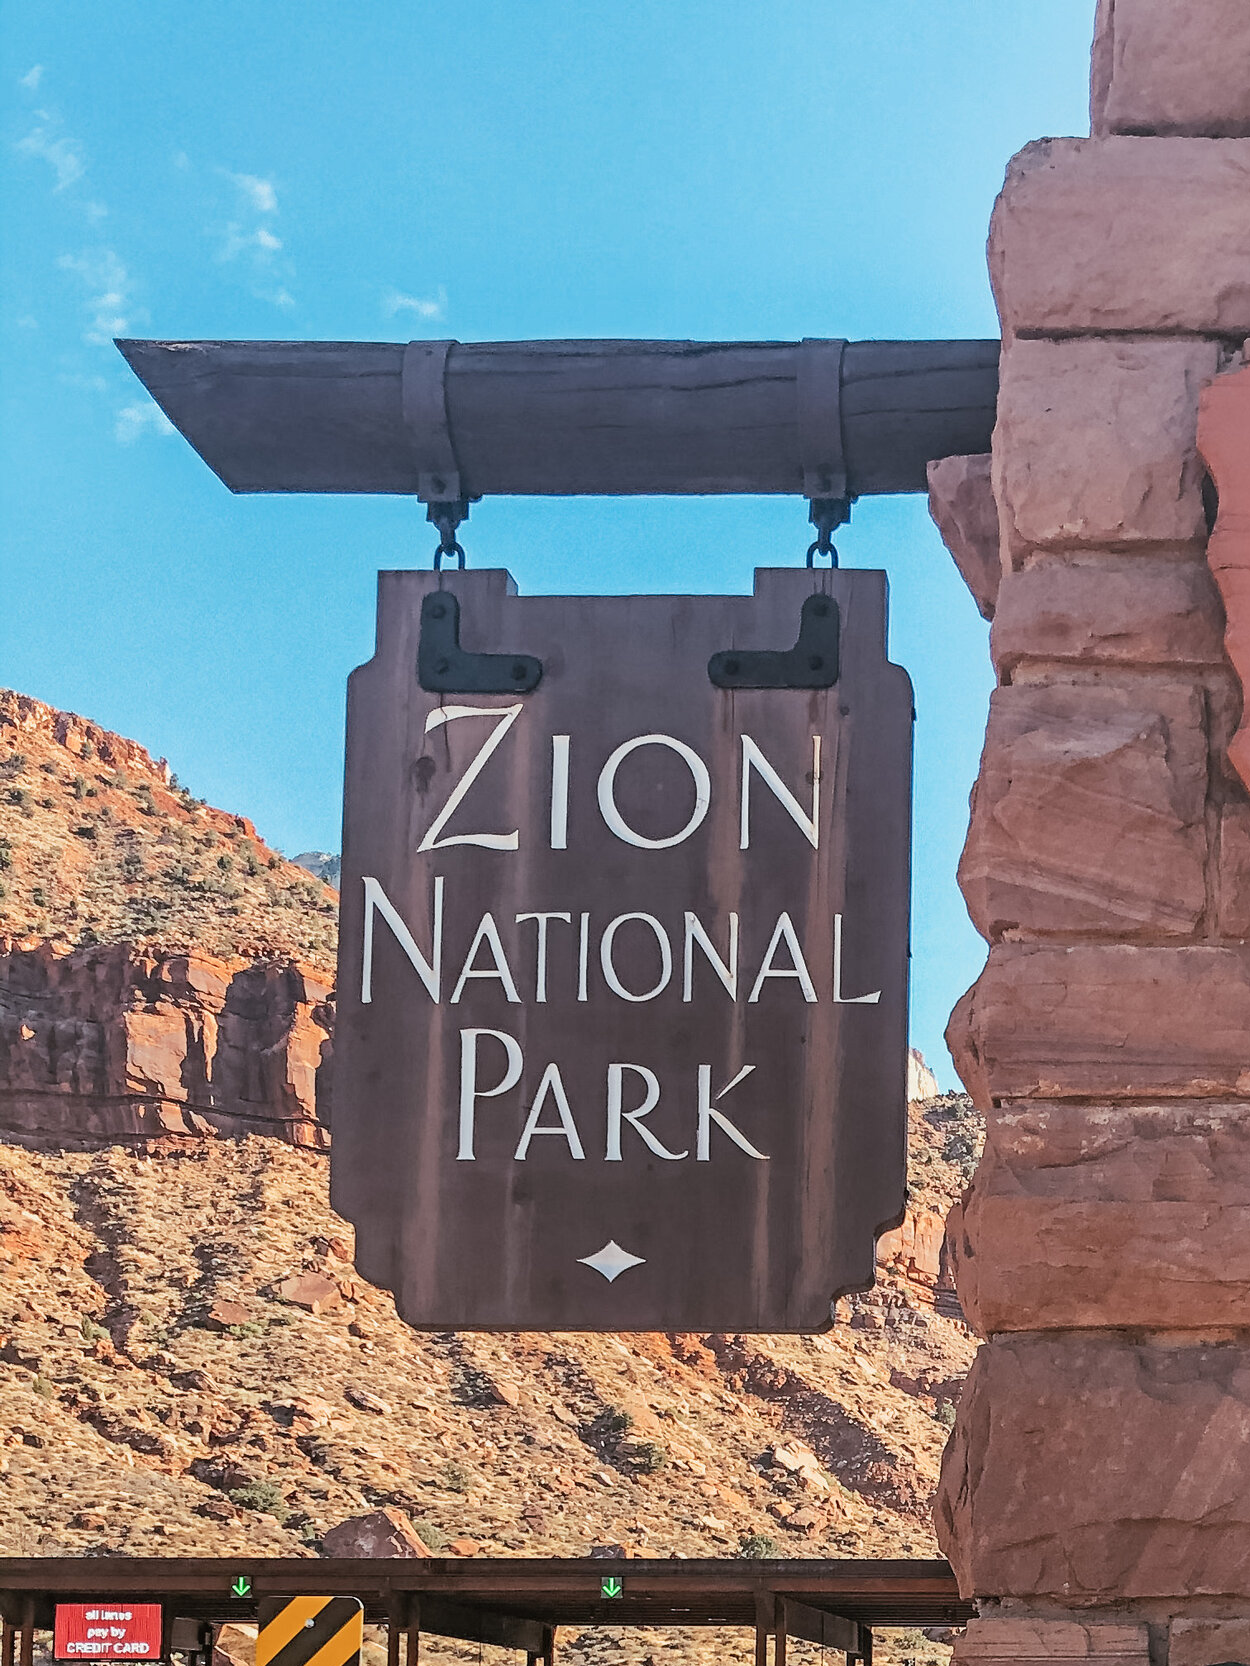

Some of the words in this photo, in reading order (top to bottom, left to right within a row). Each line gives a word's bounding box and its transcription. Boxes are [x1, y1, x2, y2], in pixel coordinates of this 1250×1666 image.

[417, 703, 822, 853] ZION
[361, 875, 882, 1005] NATIONAL
[456, 1027, 771, 1163] PARK
[66, 1642, 113, 1654] CREDIT
[113, 1642, 150, 1654] CARD
[85, 1609, 99, 1621] all
[101, 1609, 133, 1621] lanes
[87, 1627, 109, 1639] pay
[110, 1626, 126, 1639] by
